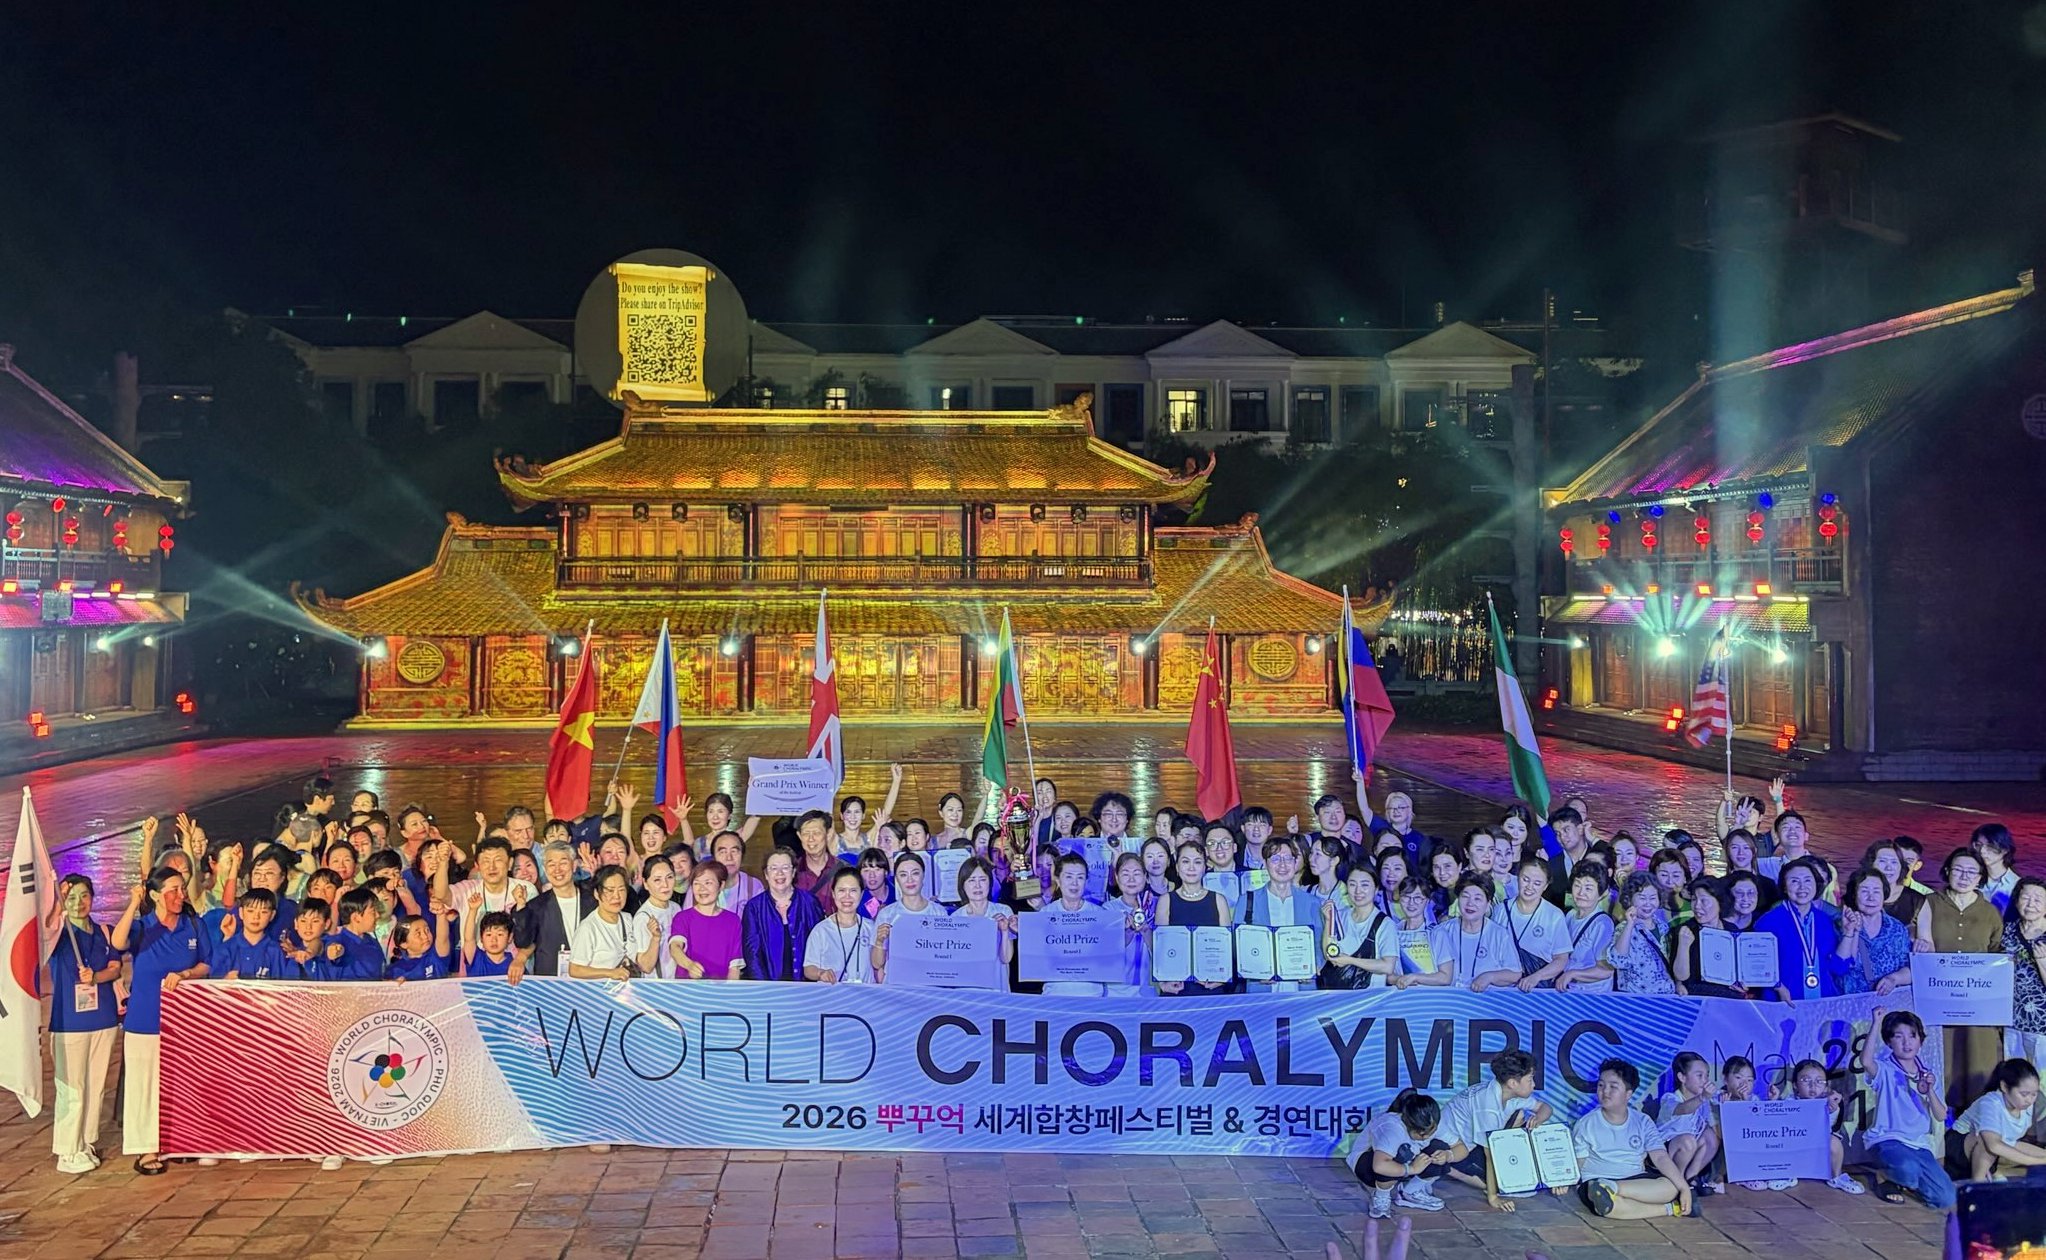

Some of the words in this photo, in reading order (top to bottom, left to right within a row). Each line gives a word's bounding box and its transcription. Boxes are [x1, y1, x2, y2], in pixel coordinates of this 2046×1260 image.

[621, 281, 631, 293] Do
[633, 284, 646, 296] you
[648, 282, 666, 297] enjoy
[668, 282, 679, 294] the
[681, 282, 703, 295] show?
[620, 297, 639, 309] Please
[641, 298, 657, 309] share
[659, 301, 667, 310] on
[668, 298, 704, 312] TripAdvisor
[752, 779, 779, 789] Grand
[781, 779, 798, 789] Prix
[800, 780, 829, 789] Winner
[915, 939, 942, 949] Silver
[946, 939, 972, 950] Prize
[1045, 934, 1071, 945] Gold
[1074, 934, 1099, 944] Prize
[1928, 977, 1964, 988] Bronze
[1966, 977, 1992, 988] Prize
[335, 1021, 370, 1056] WORLD
[373, 1013, 444, 1056] CHORALYMPIC
[536, 1007, 877, 1084] WORLD
[916, 1015, 1623, 1094] CHORALYMPIC
[1822, 1033, 1869, 1080] 28
[331, 1067, 344, 1098] 2026
[430, 1068, 444, 1094] PHU
[340, 1098, 389, 1127] VIETNAM
[401, 1095, 432, 1121] QUOC
[782, 1103, 867, 1130] 2026
[875, 1103, 964, 1135] 뿌꾸억
[974, 1103, 1214, 1136] 세계합창페스티벌
[1222, 1106, 1246, 1133] &
[1253, 1103, 1372, 1138] 경연대회
[1742, 1128, 1778, 1139] Bronze
[1781, 1126, 1808, 1137] Prize
